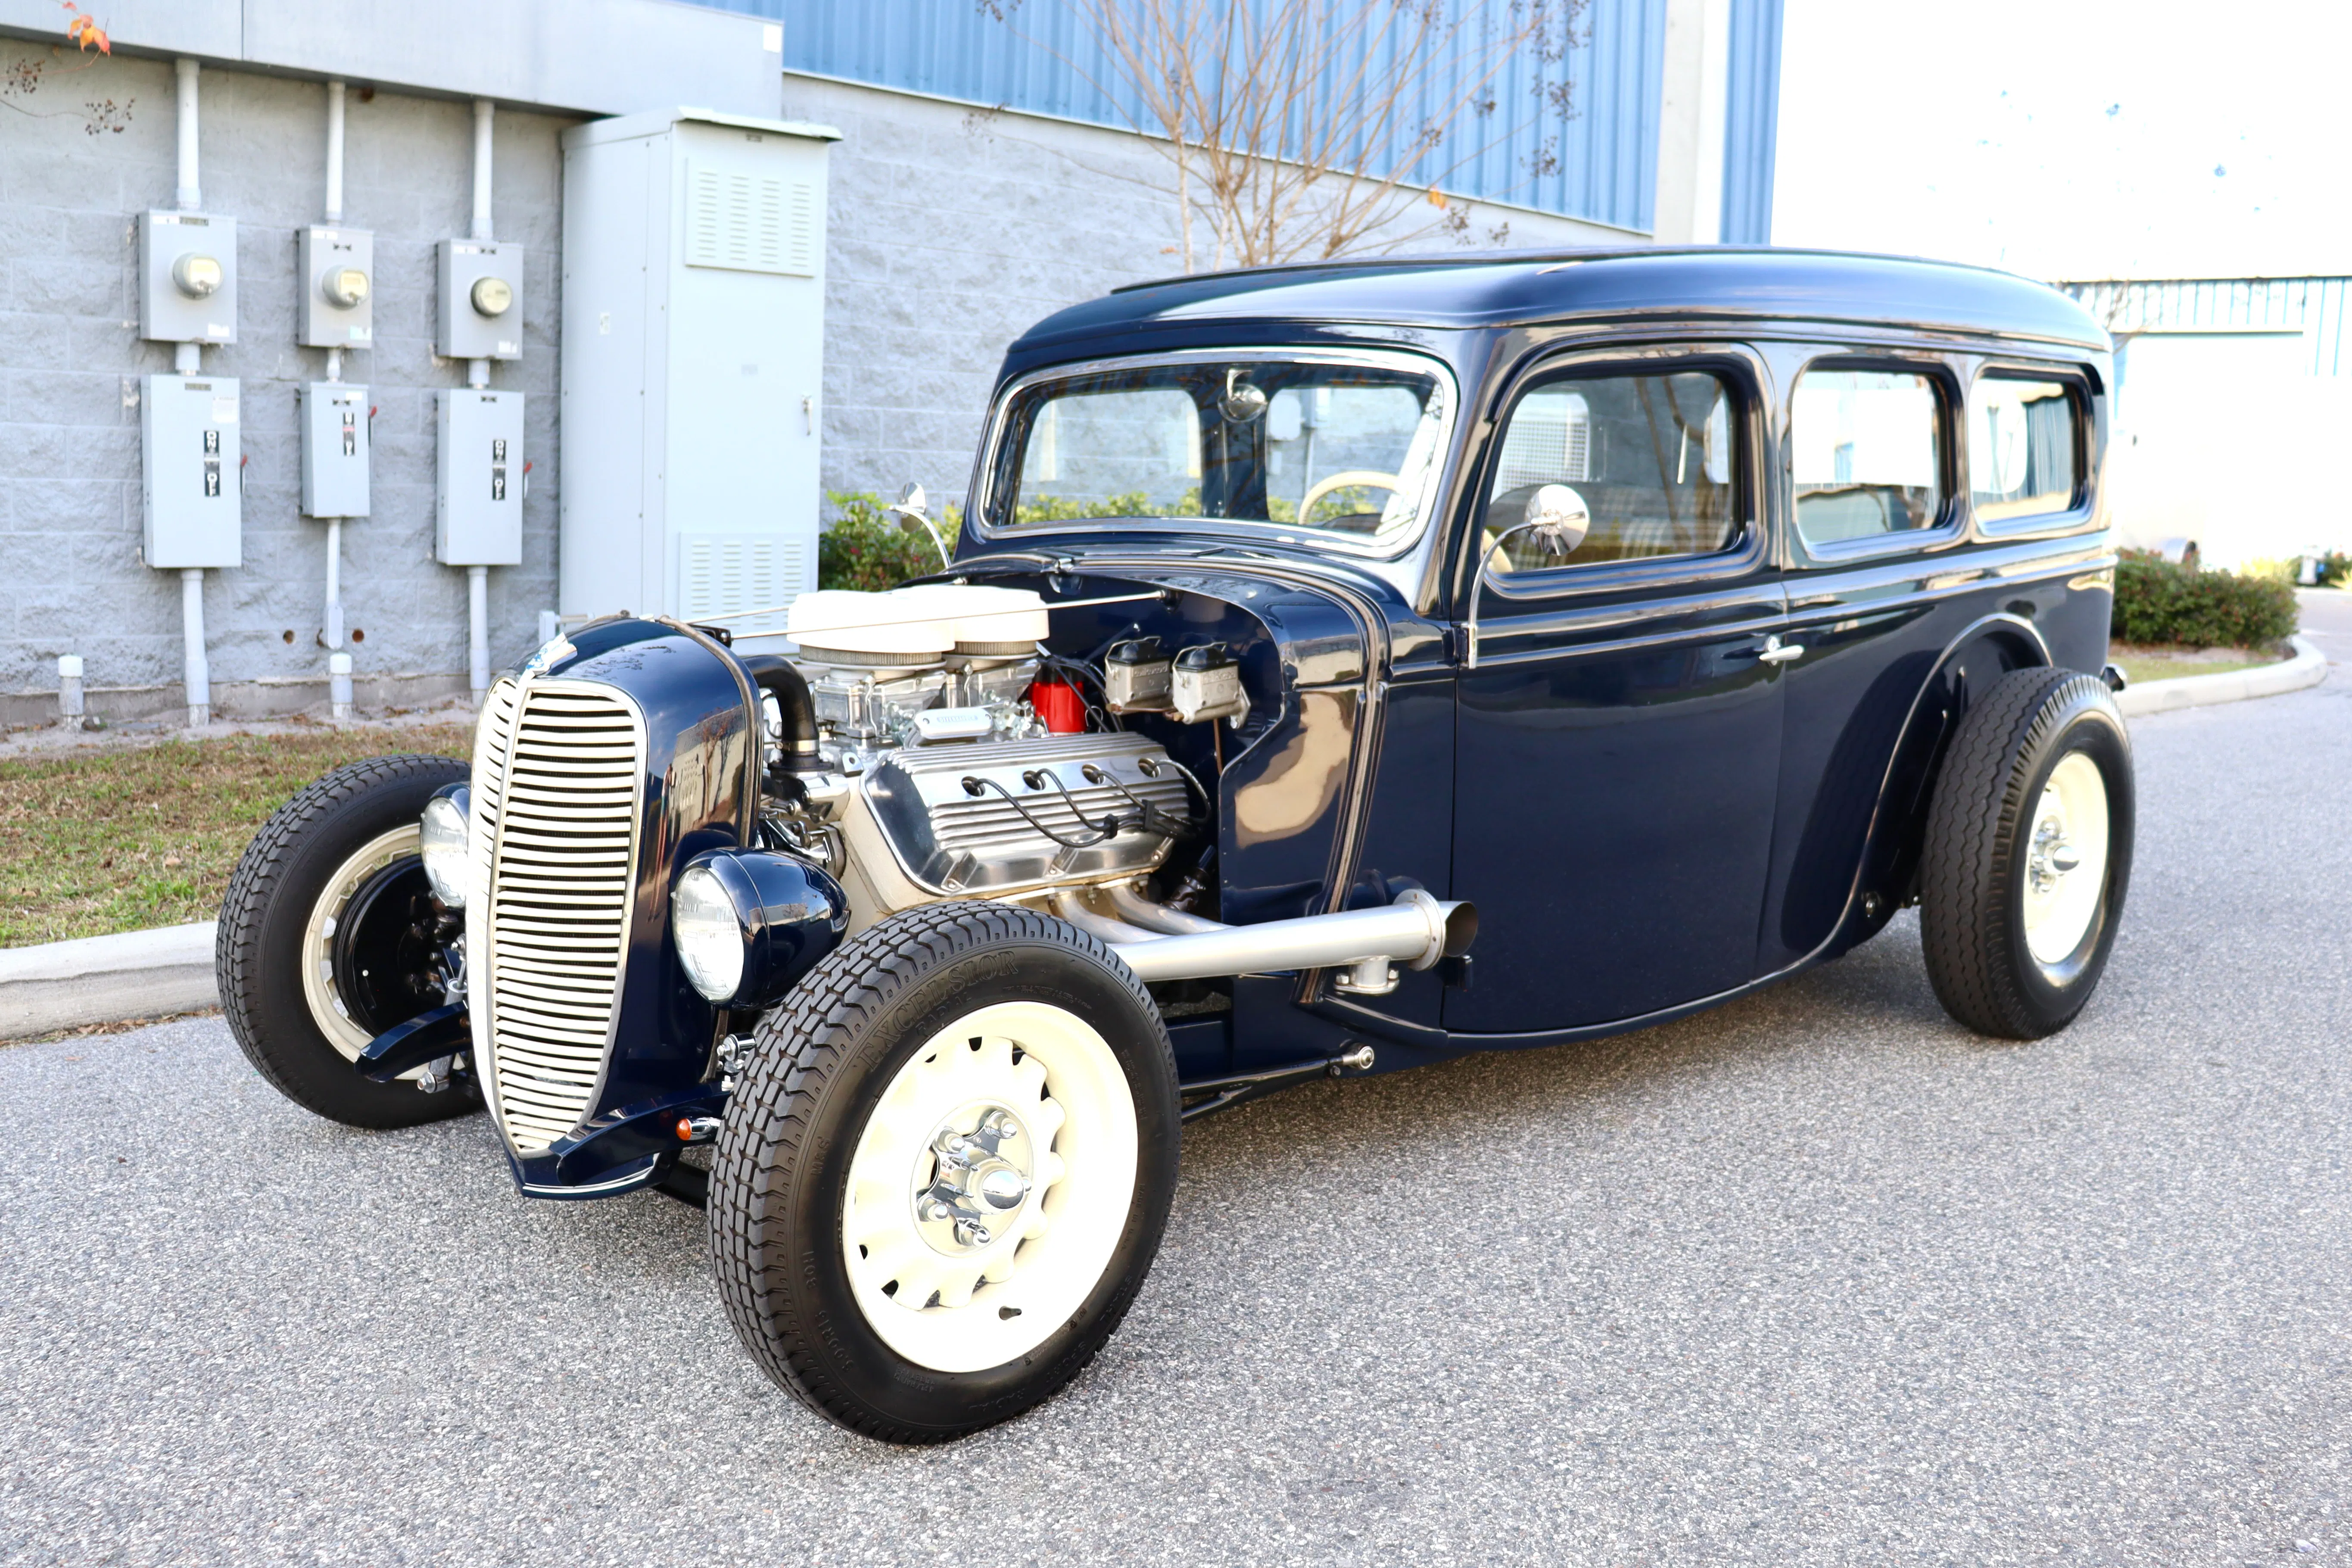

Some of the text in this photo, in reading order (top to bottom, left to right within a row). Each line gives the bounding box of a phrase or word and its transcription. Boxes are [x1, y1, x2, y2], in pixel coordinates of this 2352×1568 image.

[206, 431, 217, 448] ON
[495, 440, 504, 455] ON
[857, 951, 1019, 1072] EXCELSIOR
